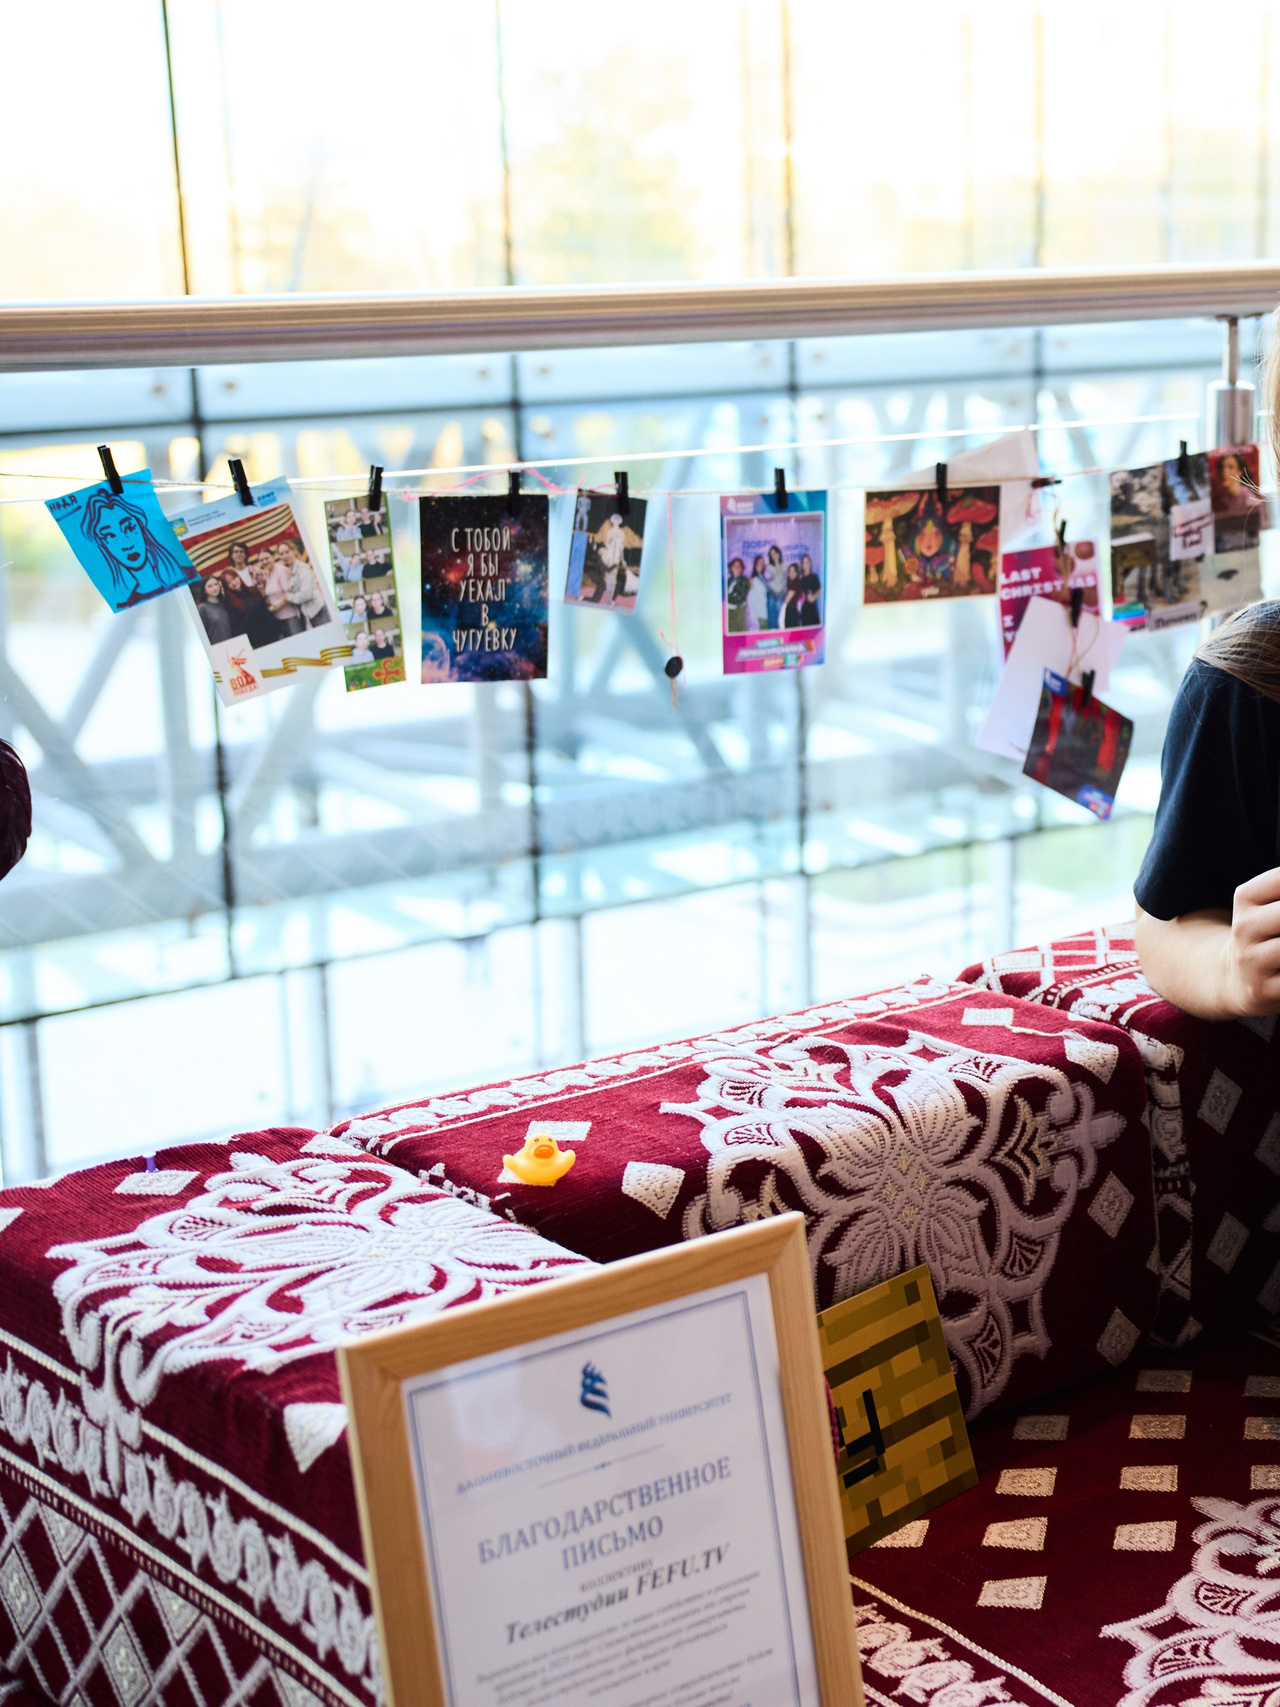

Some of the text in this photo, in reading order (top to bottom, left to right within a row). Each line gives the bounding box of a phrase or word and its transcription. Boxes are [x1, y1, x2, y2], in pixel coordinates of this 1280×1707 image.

[452, 526, 511, 552] С ТОБОЙ
[467, 553, 499, 576] Я БЫ
[999, 566, 1042, 584] LAST
[459, 577, 506, 602] УЕХАЛ
[481, 603, 489, 627] В
[452, 628, 517, 652] ЧУГУЕВКУ
[477, 1456, 732, 1565] БЛАГОДАРСТВЕННОЕ
[561, 1515, 665, 1571] ПИСЬМО
[507, 1586, 630, 1645] Телестудии
[636, 1542, 730, 1596] FEFU.TV
